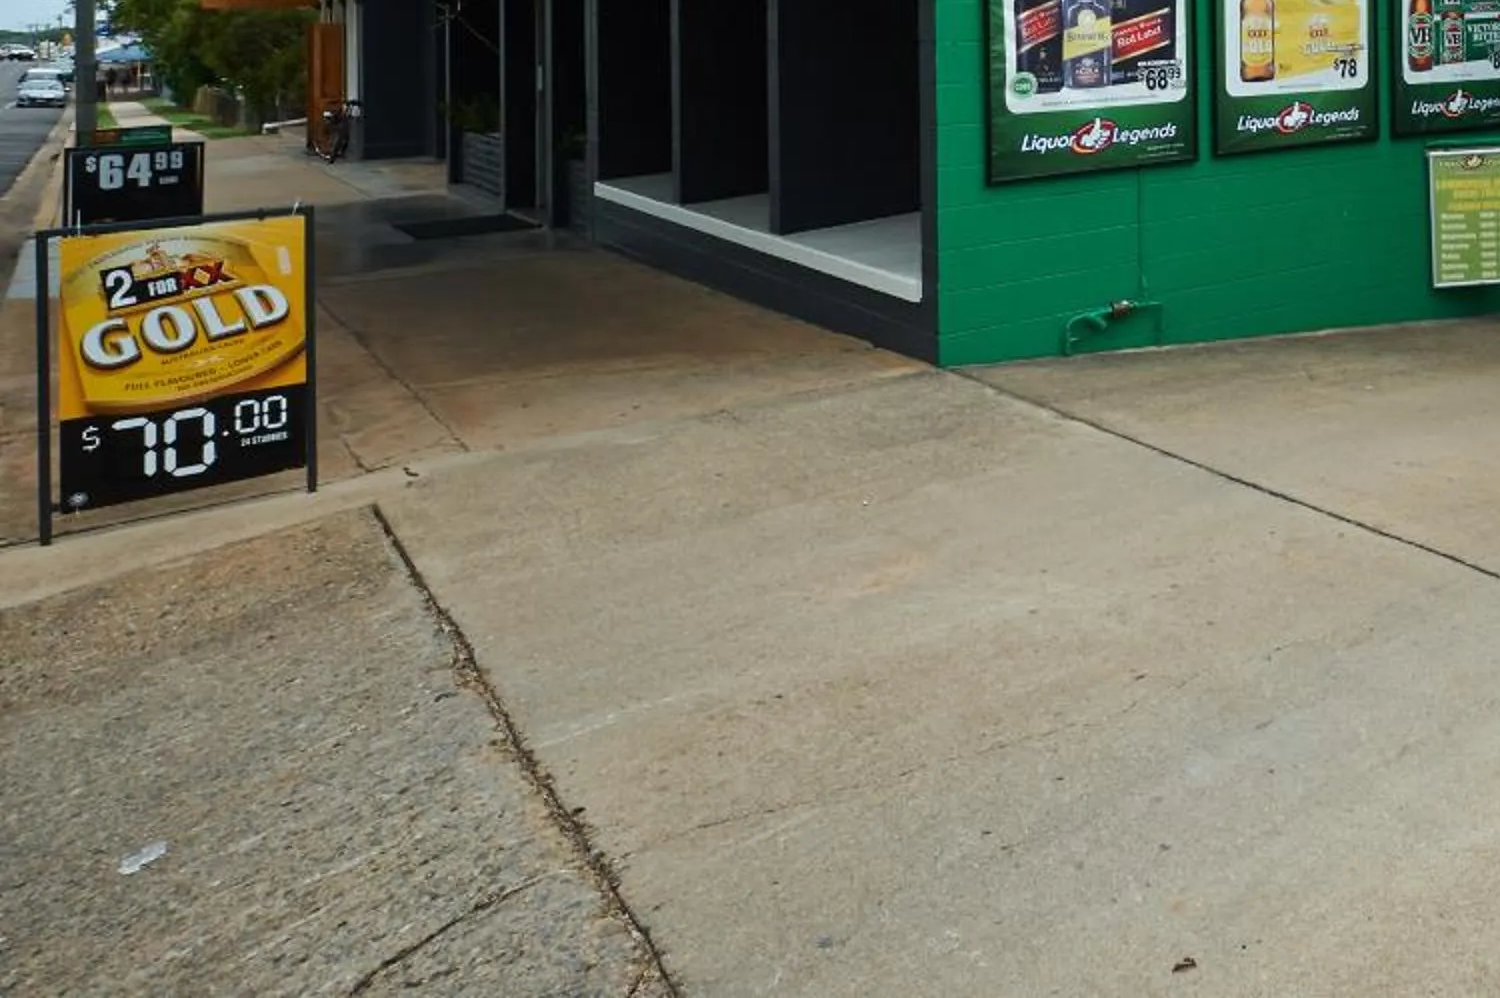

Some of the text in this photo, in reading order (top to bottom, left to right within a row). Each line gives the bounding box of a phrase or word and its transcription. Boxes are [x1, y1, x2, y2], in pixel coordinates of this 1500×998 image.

[1310, 107, 1360, 126] Legends
[1021, 122, 1177, 154] Liquor Legends
[105, 269, 177, 308] 2 FOR
[81, 284, 290, 369] GOLD
